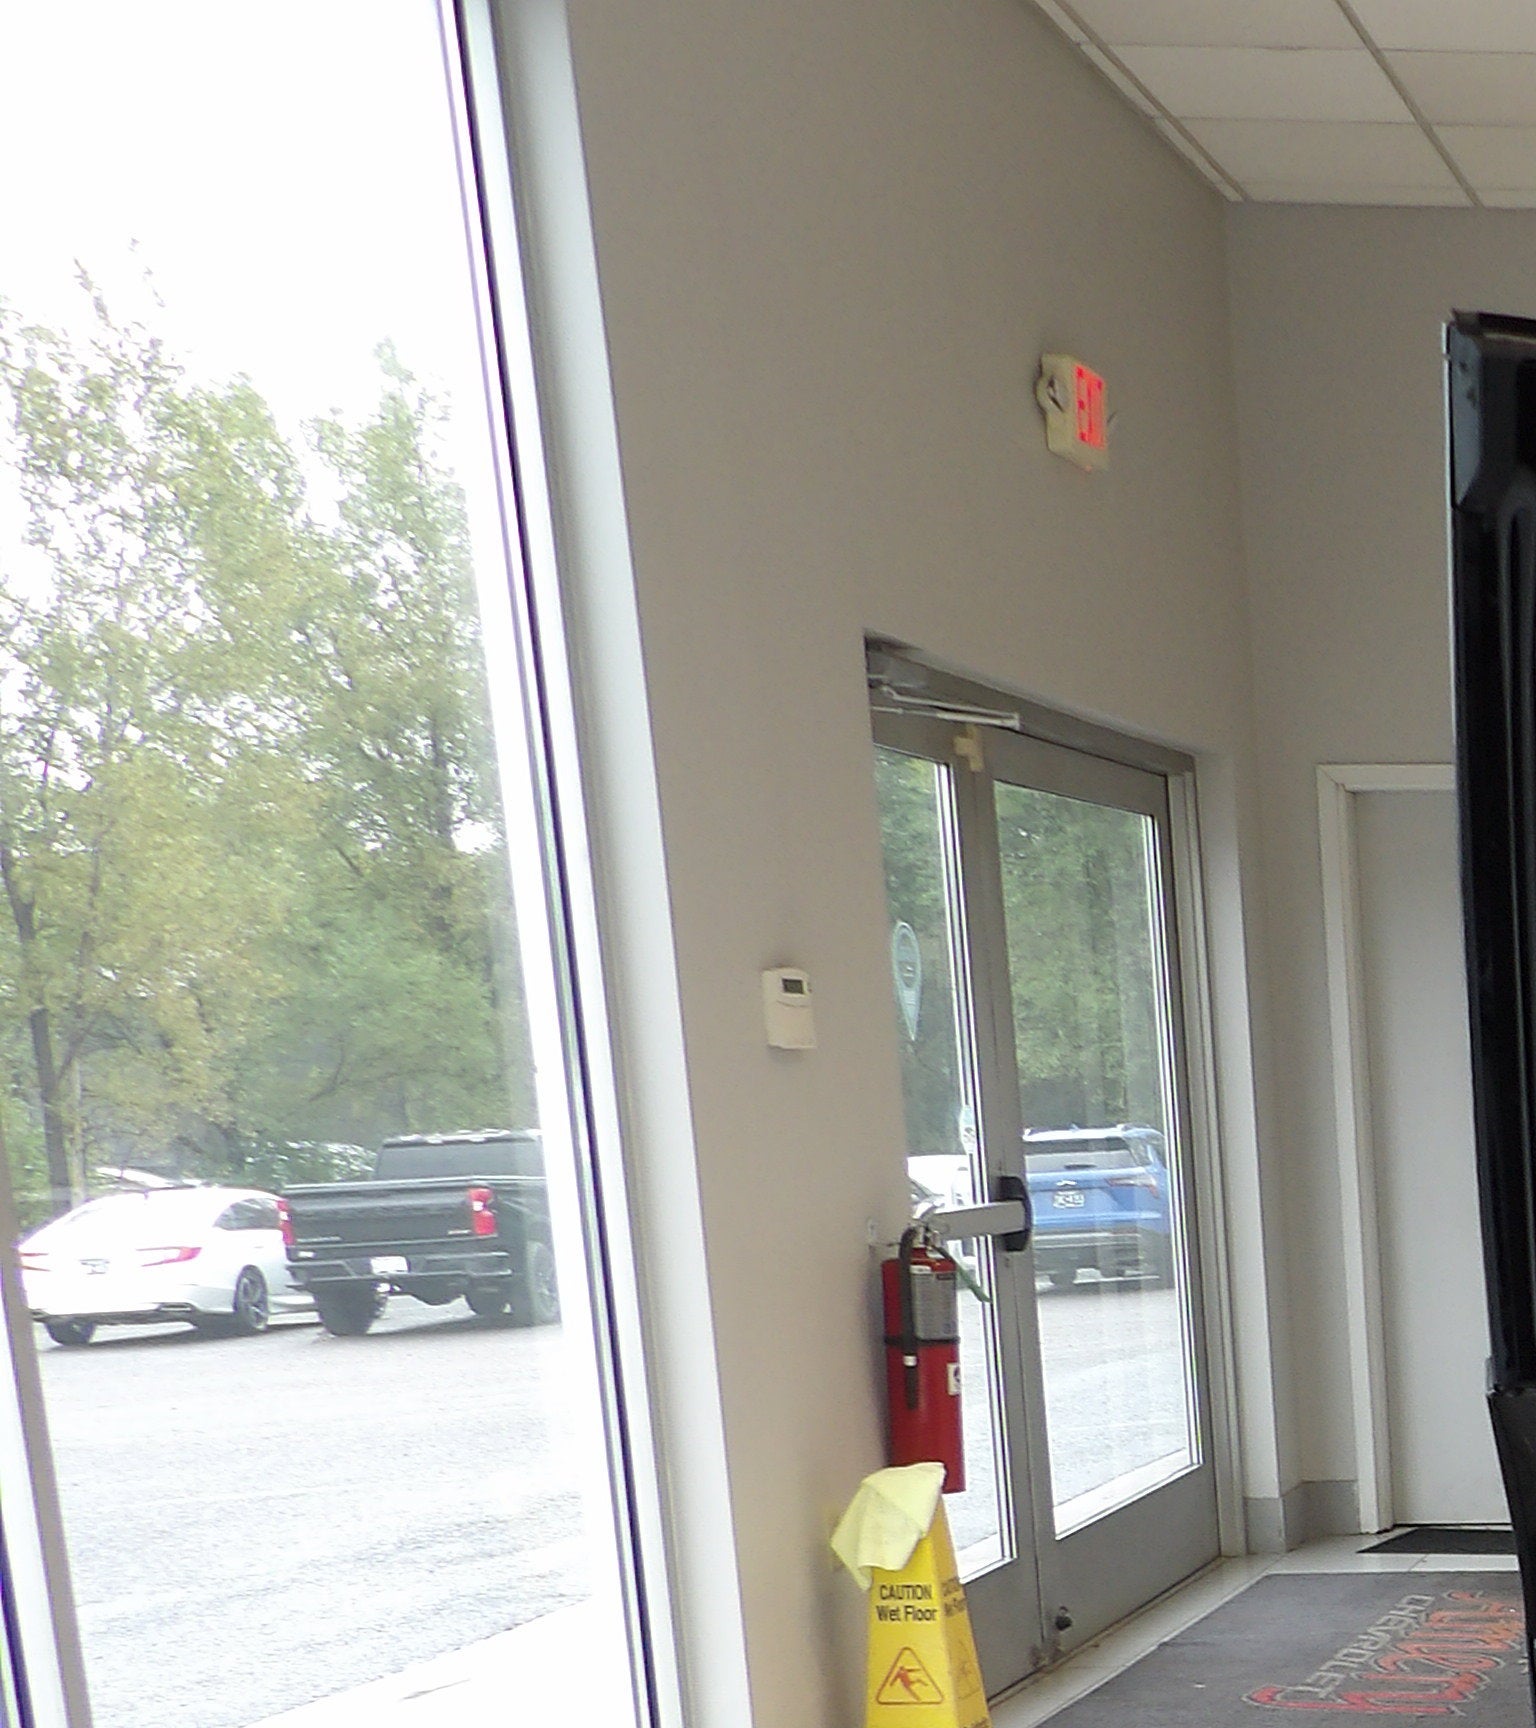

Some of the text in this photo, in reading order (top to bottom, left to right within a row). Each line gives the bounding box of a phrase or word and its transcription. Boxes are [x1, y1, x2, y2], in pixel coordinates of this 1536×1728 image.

[880, 1584, 932, 1600] CAUTION
[876, 1605, 901, 1622] Wet
[904, 1605, 938, 1622] Floor
[1294, 1593, 1436, 1697] CHEVROLET
